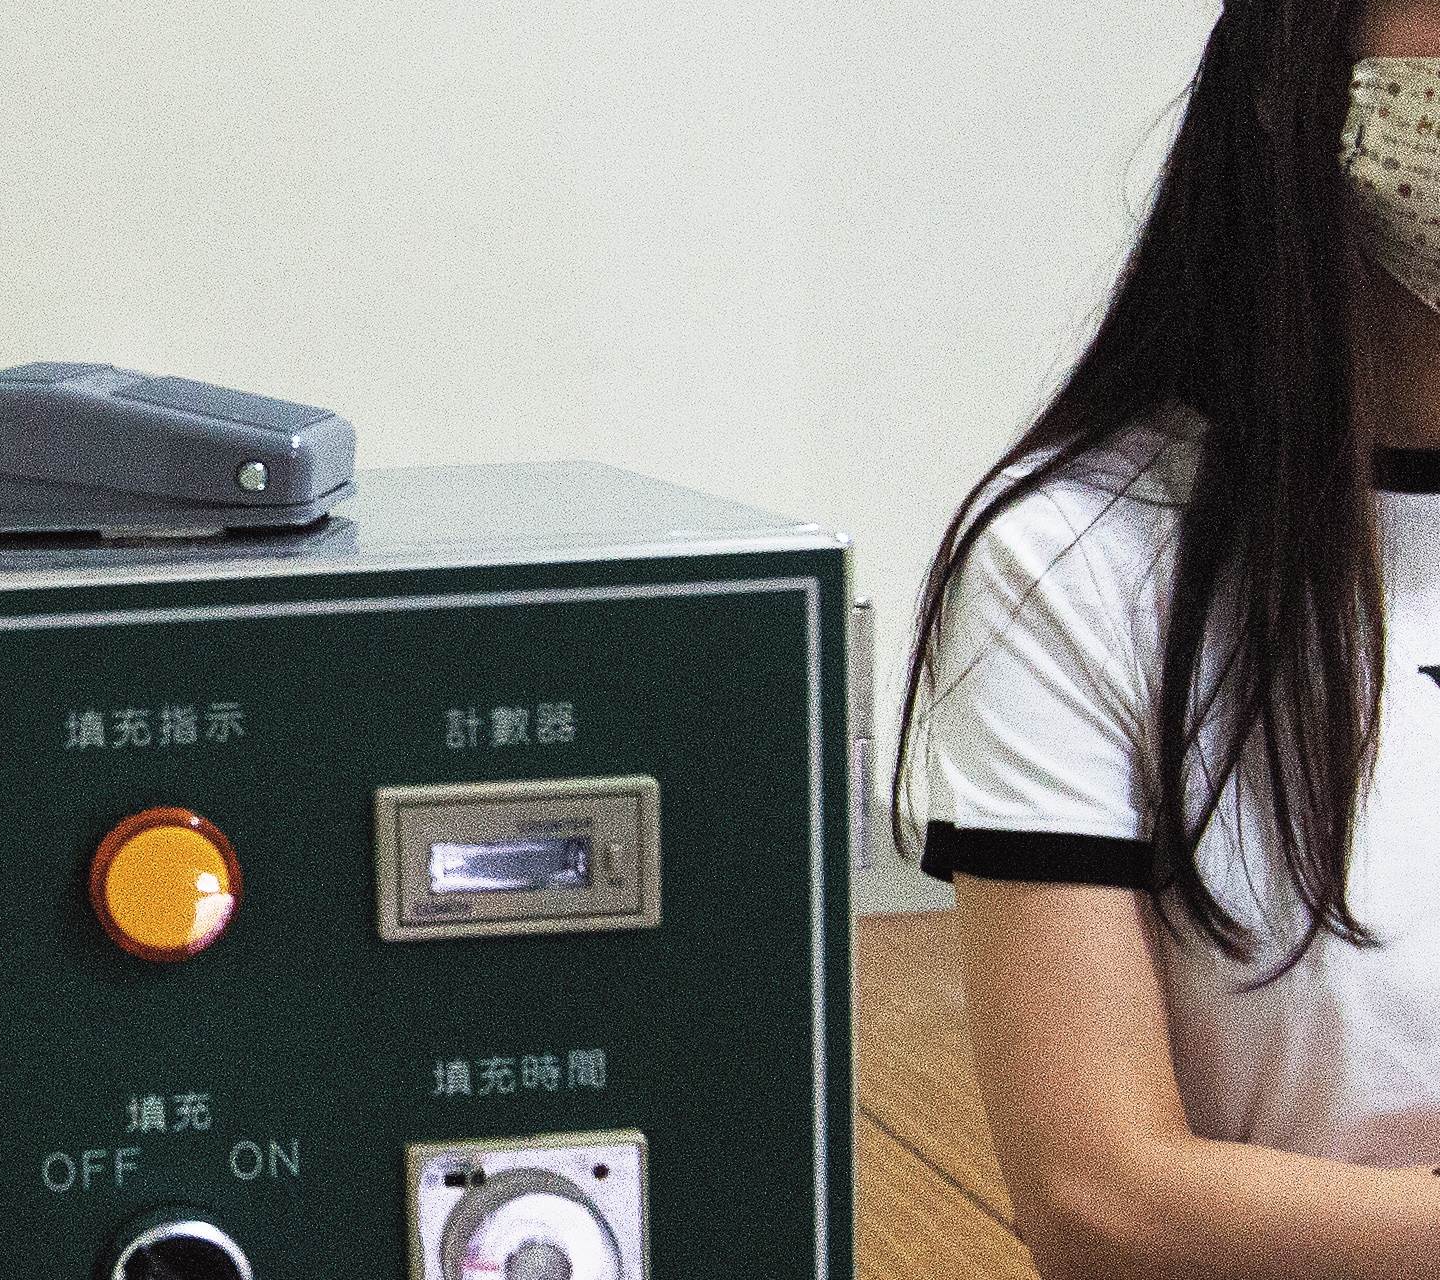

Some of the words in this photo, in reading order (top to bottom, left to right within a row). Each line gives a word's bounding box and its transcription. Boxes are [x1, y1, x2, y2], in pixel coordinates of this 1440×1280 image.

[446, 702, 576, 749] 計數器
[41, 1146, 141, 1193] OFF
[229, 1139, 300, 1181] ON
